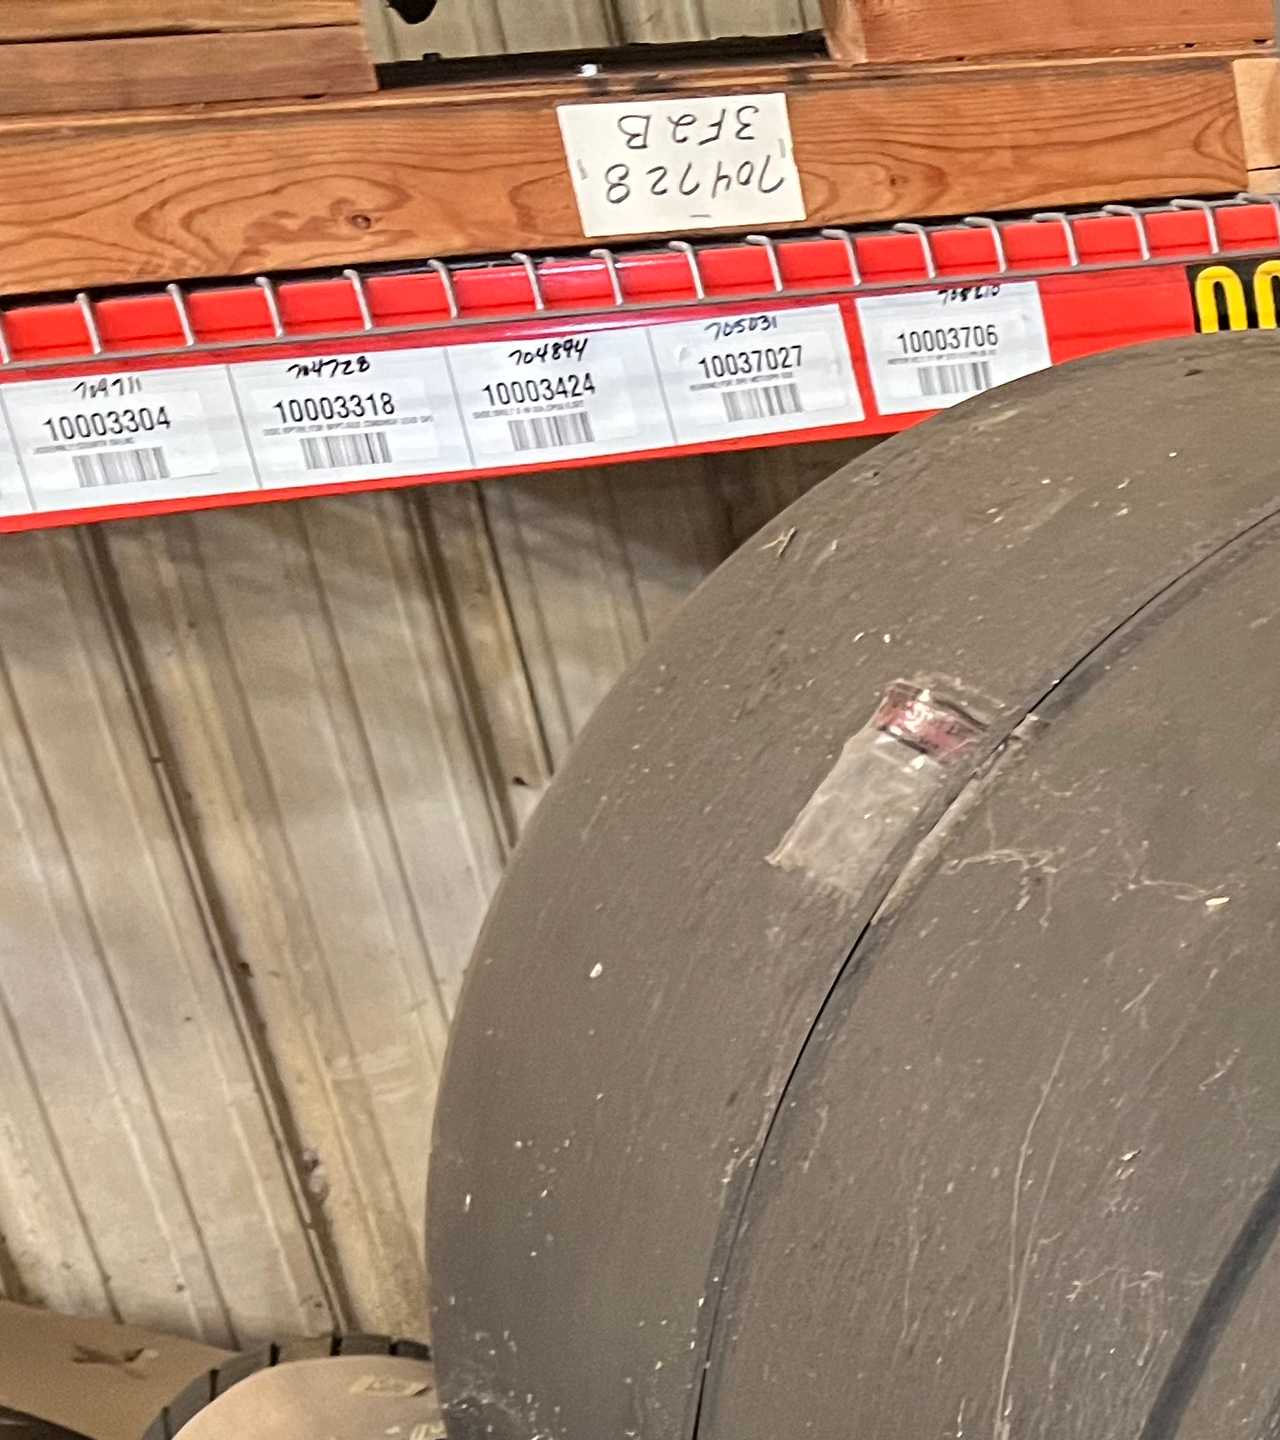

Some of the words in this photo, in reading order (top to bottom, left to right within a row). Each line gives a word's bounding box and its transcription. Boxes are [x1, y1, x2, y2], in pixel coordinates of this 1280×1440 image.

[604, 154, 785, 204] 704728
[704, 315, 778, 340] 705031
[897, 324, 999, 354] 10003706
[698, 345, 802, 379] 10037027
[482, 372, 596, 407] 10003424
[43, 406, 172, 442] 10003304
[273, 392, 396, 424] 10003318
